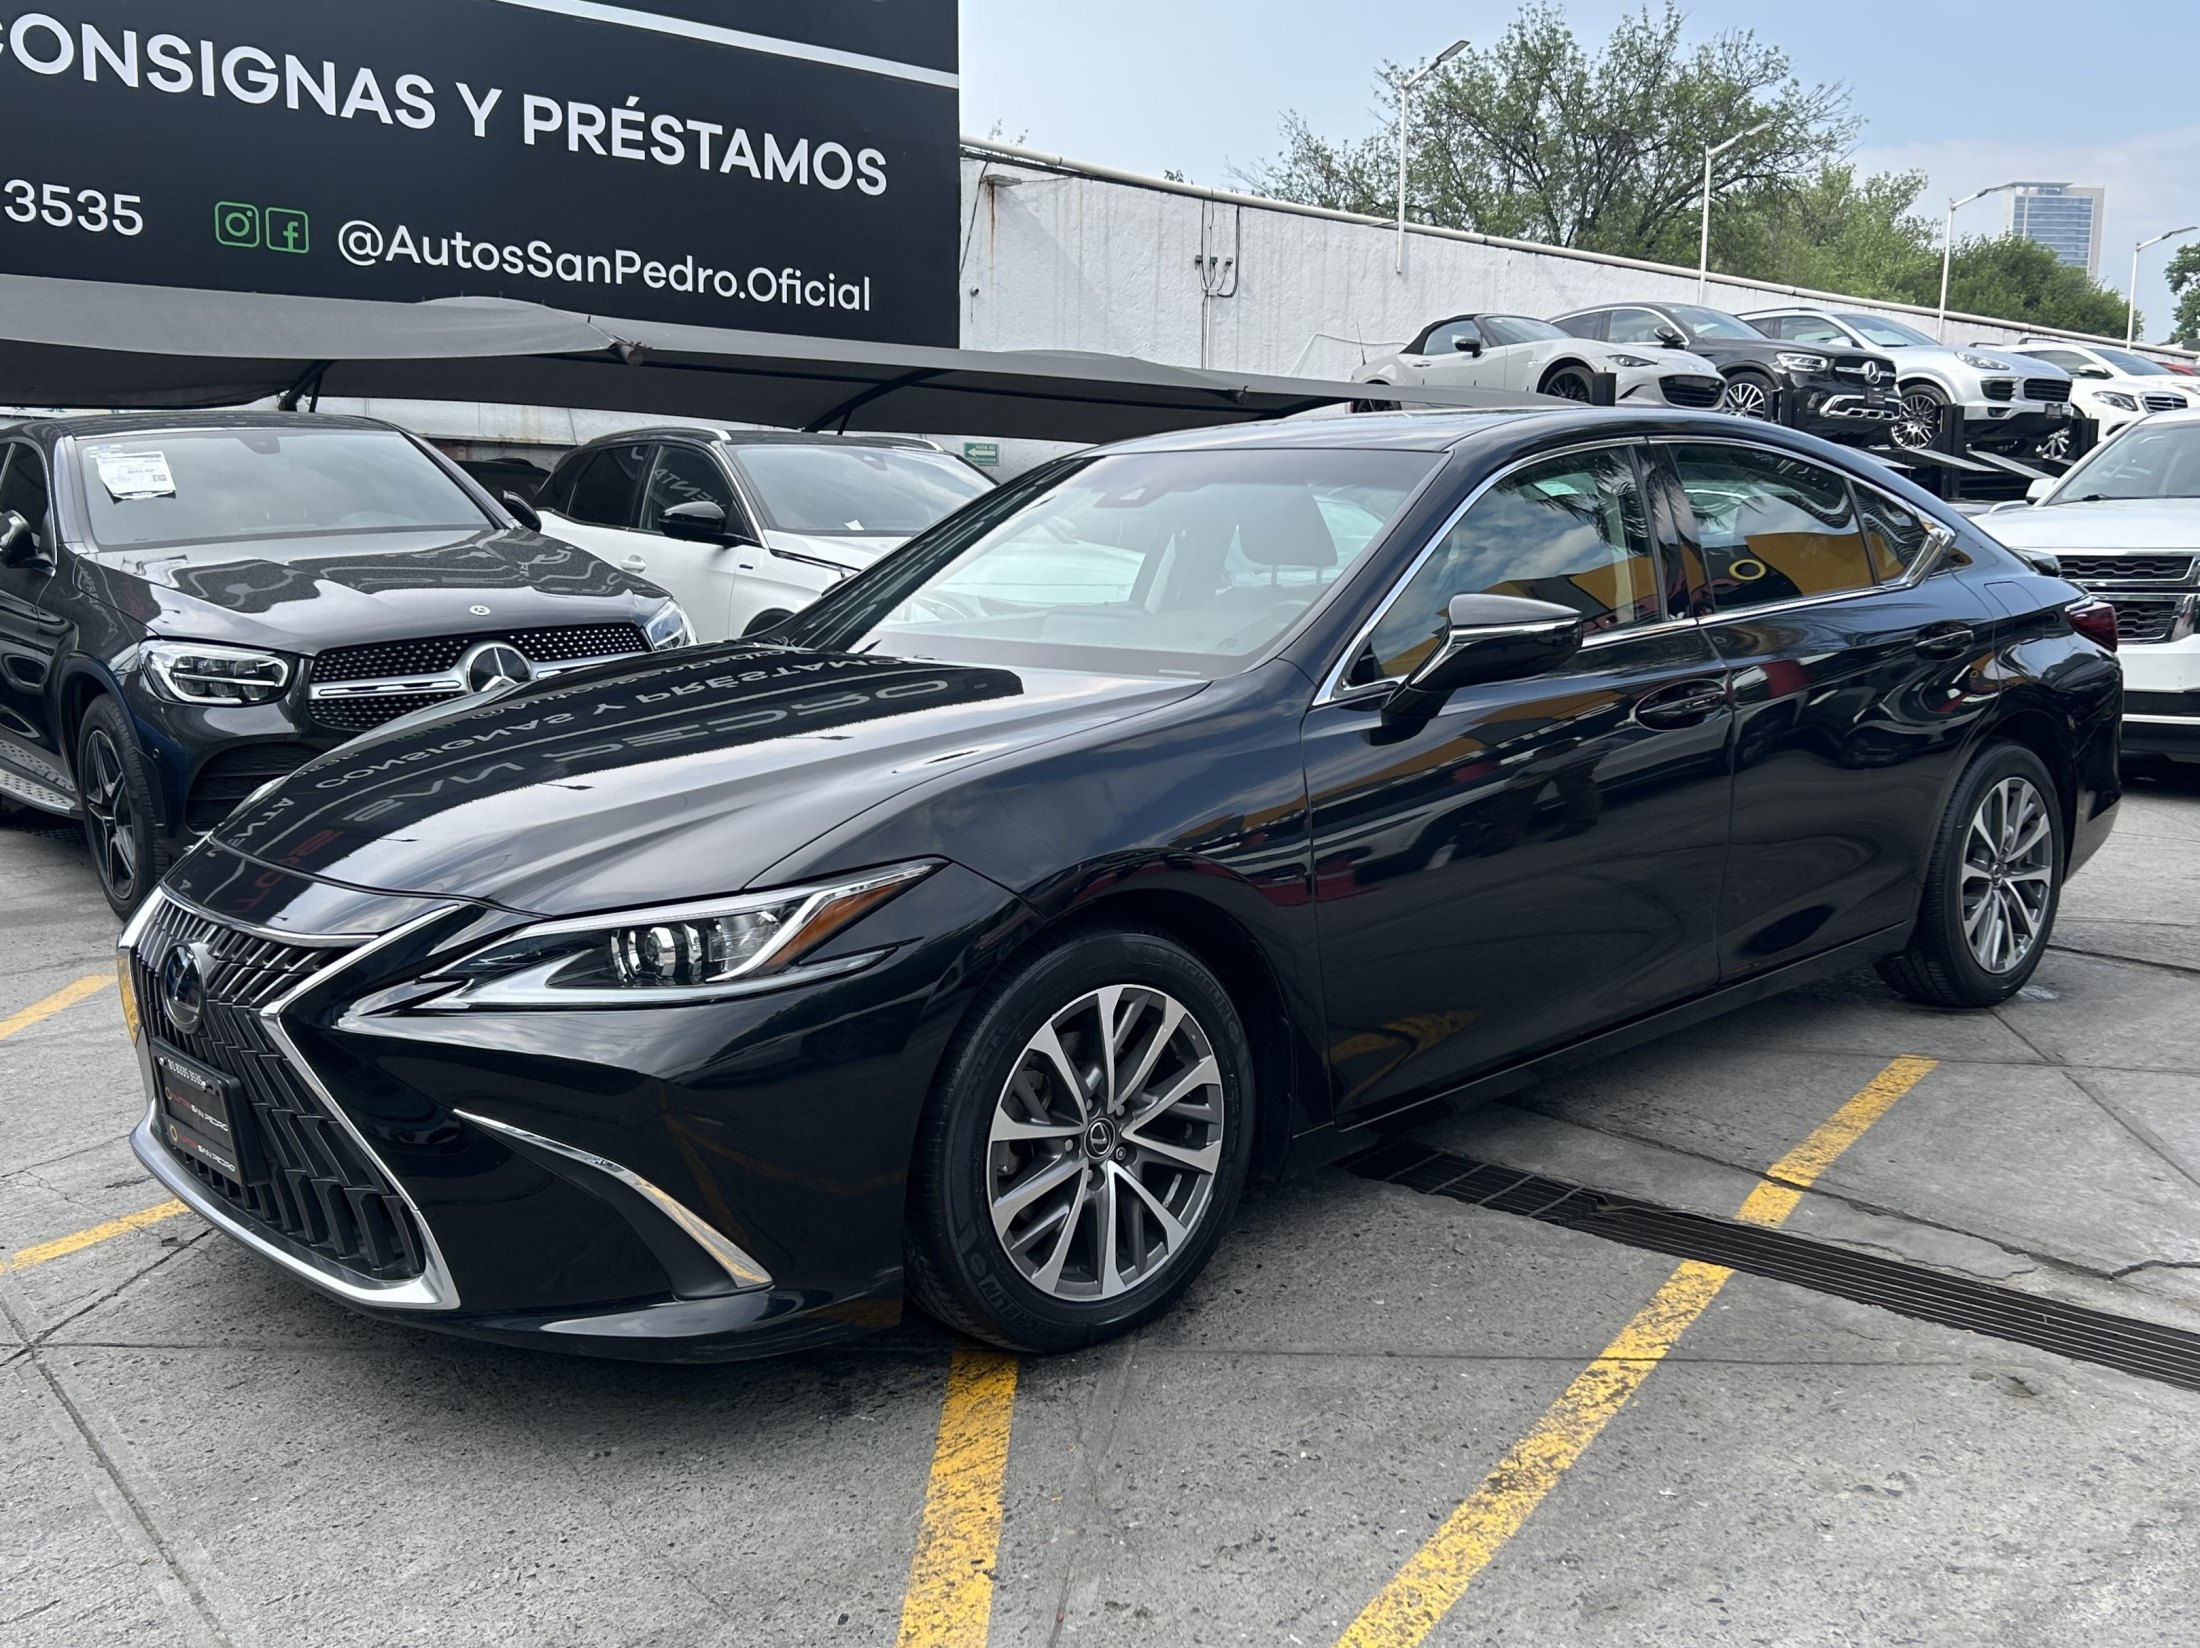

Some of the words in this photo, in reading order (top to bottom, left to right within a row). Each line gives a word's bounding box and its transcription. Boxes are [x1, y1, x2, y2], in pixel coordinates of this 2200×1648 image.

[0, 12, 436, 130] ONSIGNAS
[455, 81, 503, 138] Y
[522, 94, 888, 197] PRÉSTAMOS
[3, 178, 144, 237] 3535
[338, 220, 870, 311] @AutosSanPedro.Oficial
